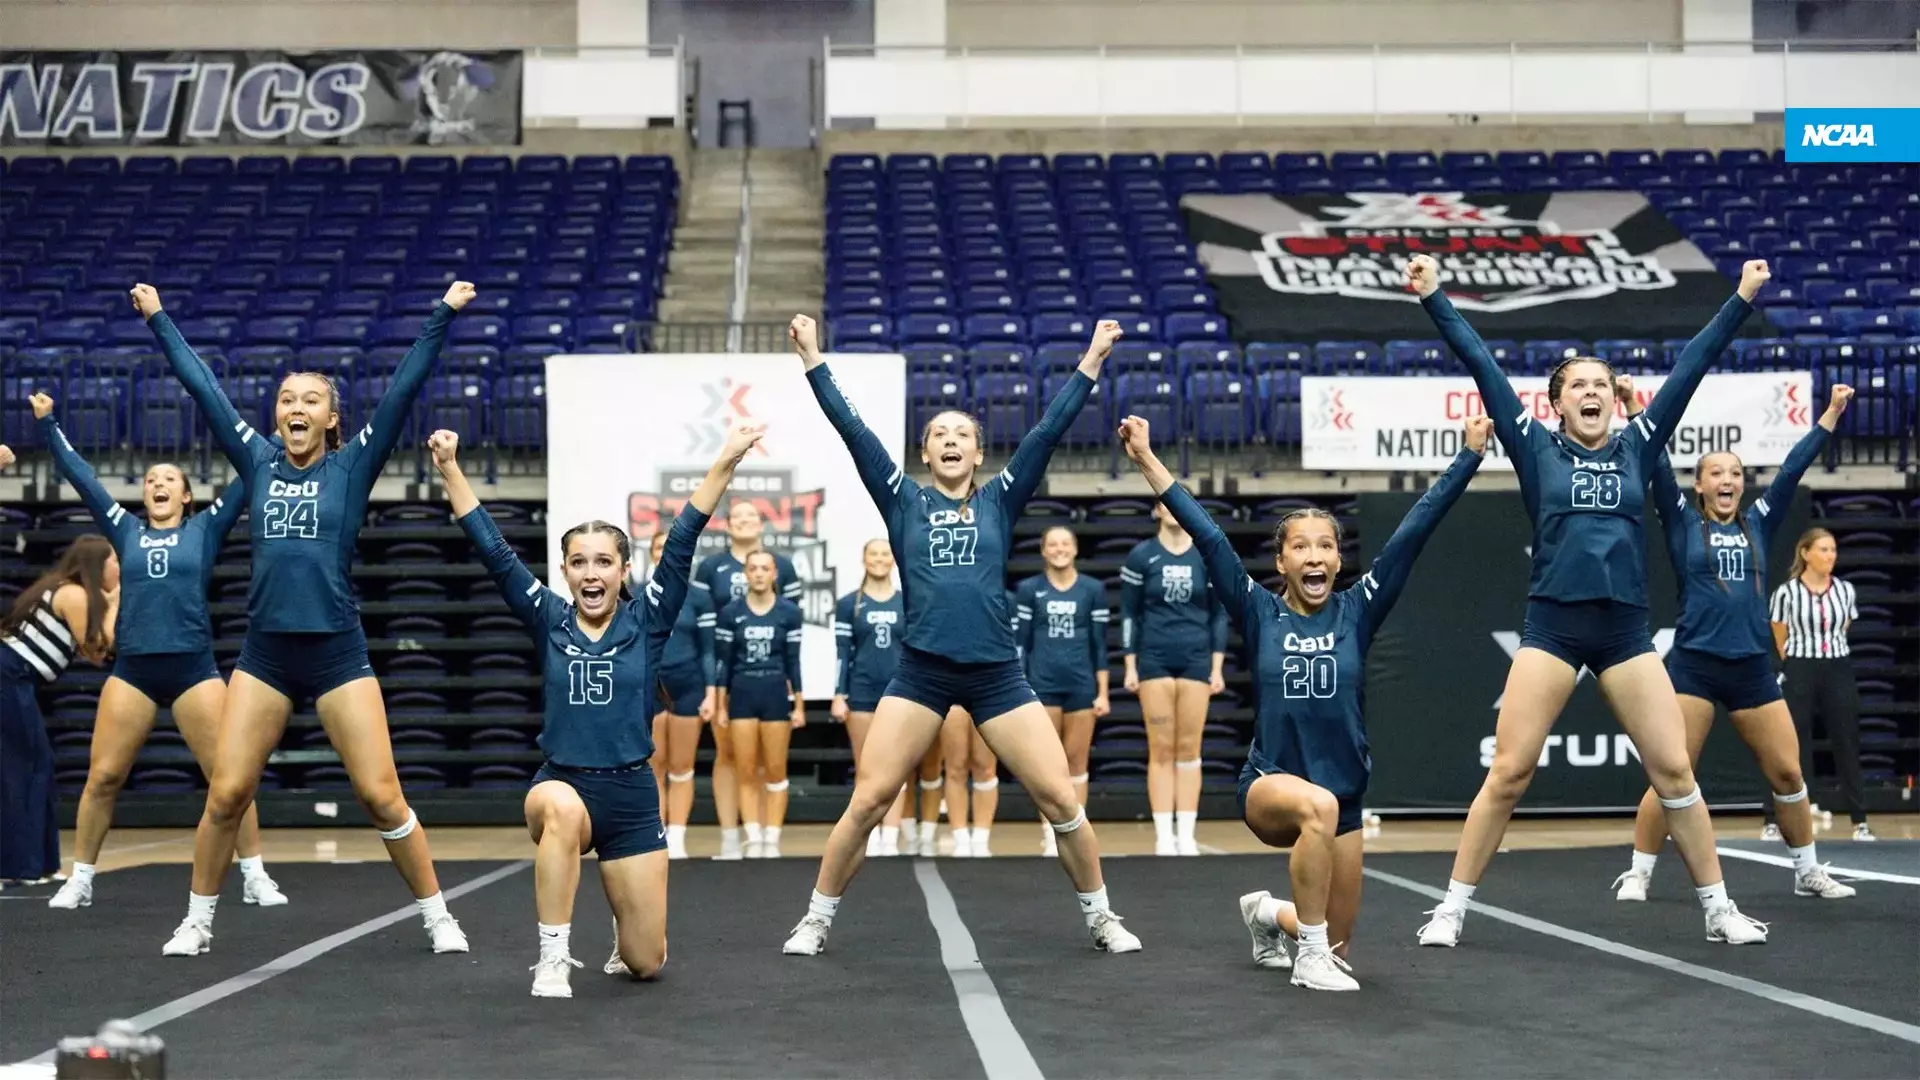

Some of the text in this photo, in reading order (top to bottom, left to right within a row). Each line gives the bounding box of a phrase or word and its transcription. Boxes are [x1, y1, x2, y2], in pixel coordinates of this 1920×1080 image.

[0, 63, 370, 138] NATICS
[1377, 429, 1509, 457] NATIOA
[268, 480, 319, 497] CBU
[670, 477, 783, 492] COEGE
[1571, 471, 1621, 509] 28
[263, 500, 318, 538] 24
[929, 507, 975, 526] CBU
[929, 526, 978, 567] 27
[1710, 532, 1749, 547] CBU
[147, 548, 169, 578] 8
[1717, 548, 1745, 581] 11
[1162, 578, 1194, 603] 75
[875, 623, 892, 649] 3
[1048, 615, 1075, 639] 14
[1283, 632, 1335, 652] CBU
[568, 660, 613, 704] 15
[1283, 654, 1337, 698] 20
[1479, 733, 1643, 767] TUN
